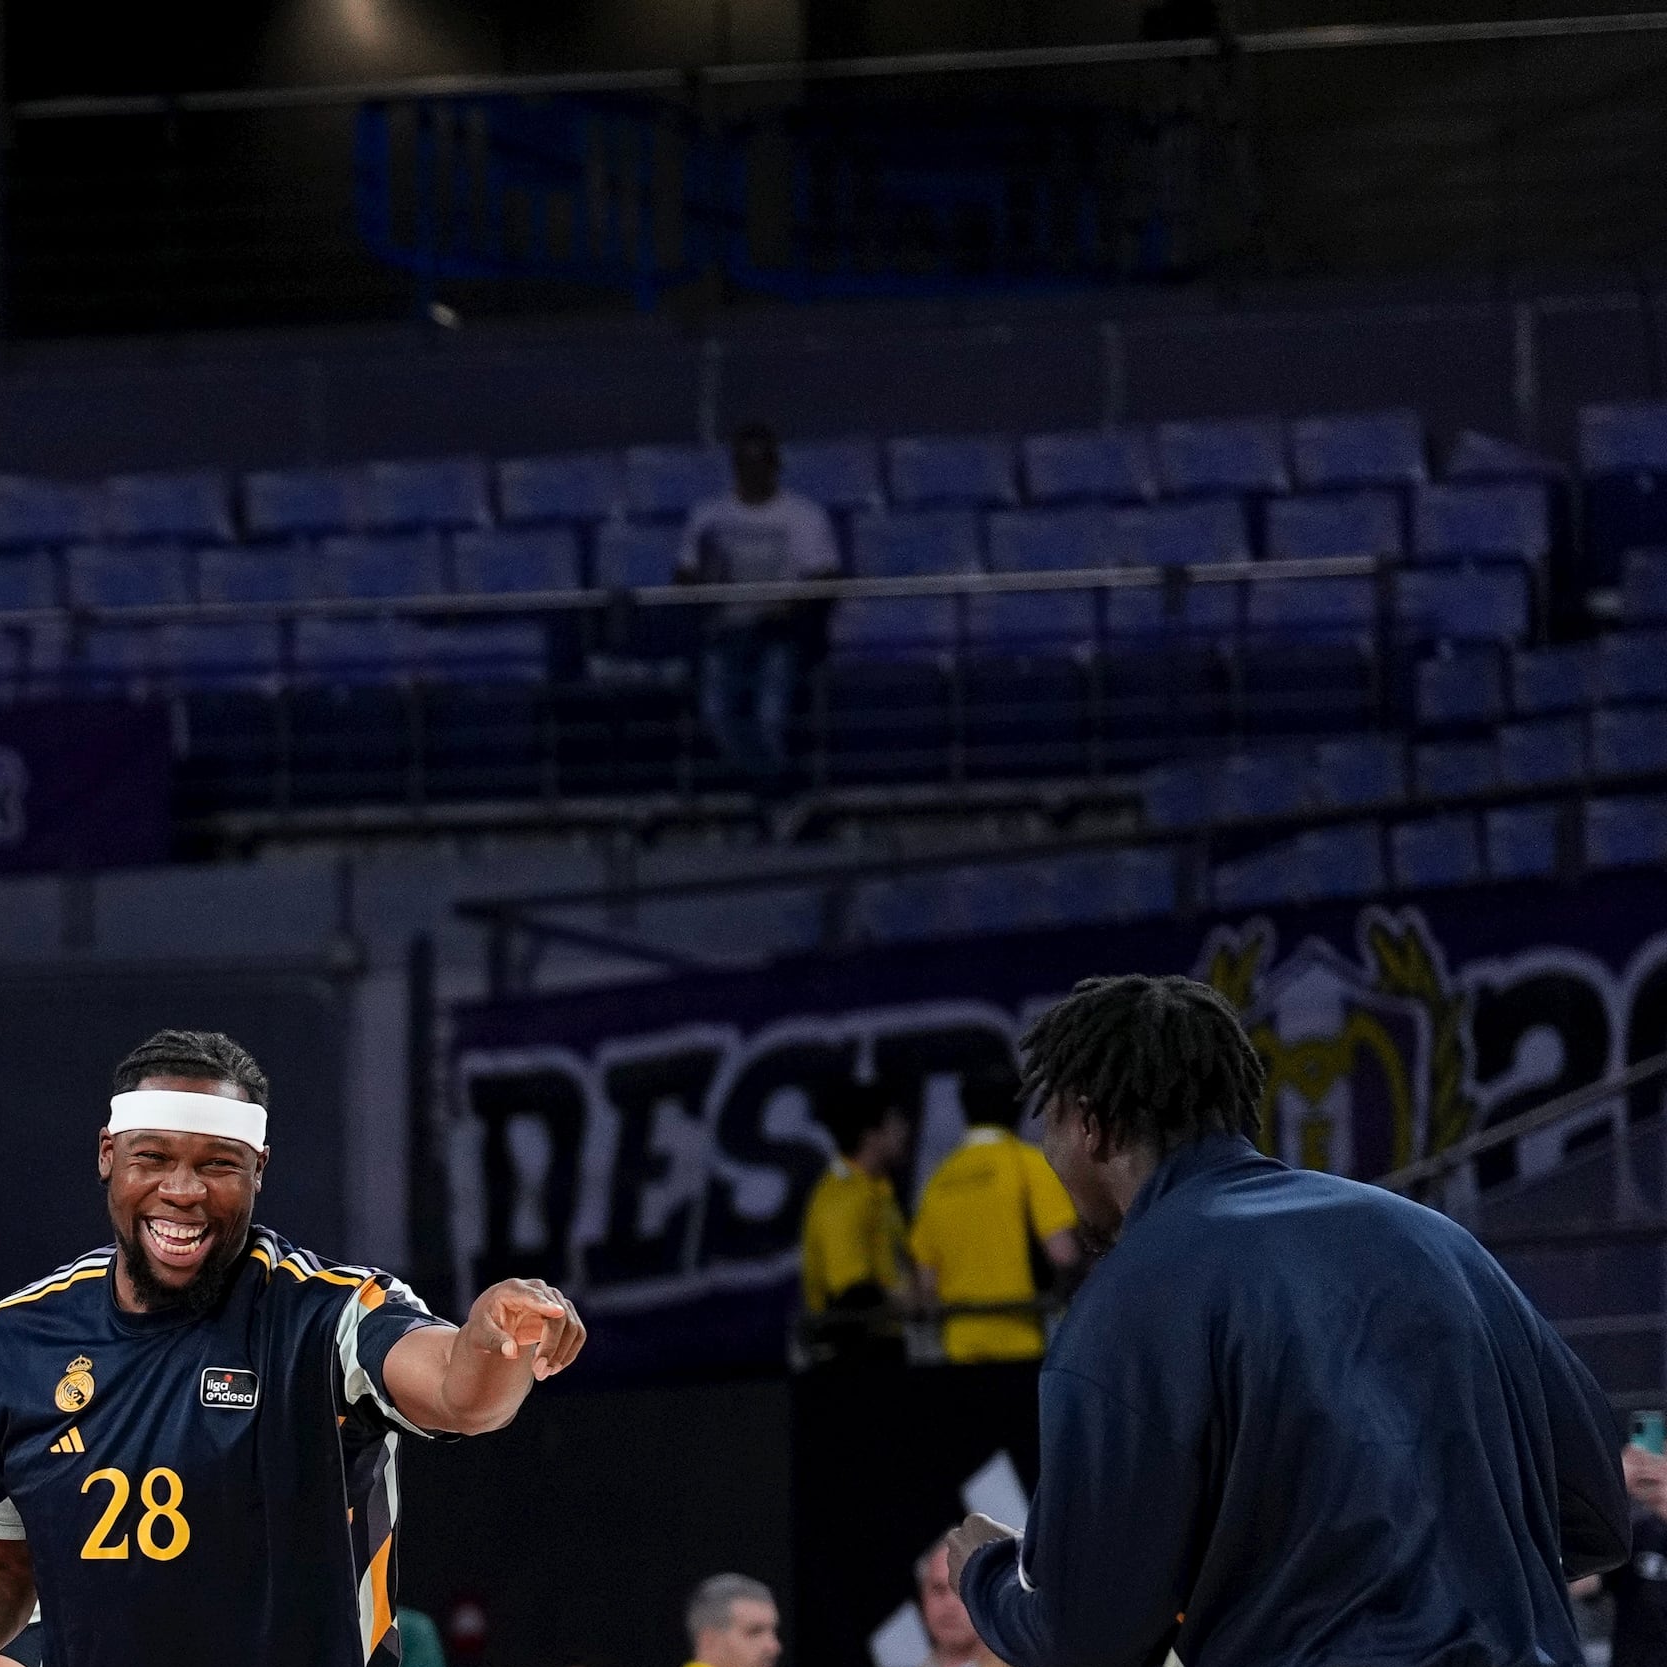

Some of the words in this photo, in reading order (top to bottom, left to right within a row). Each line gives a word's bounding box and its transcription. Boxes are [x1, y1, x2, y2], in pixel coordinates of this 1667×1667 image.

[207, 1378, 229, 1394] liga
[206, 1390, 253, 1404] endesa
[80, 1466, 192, 1562] 28
